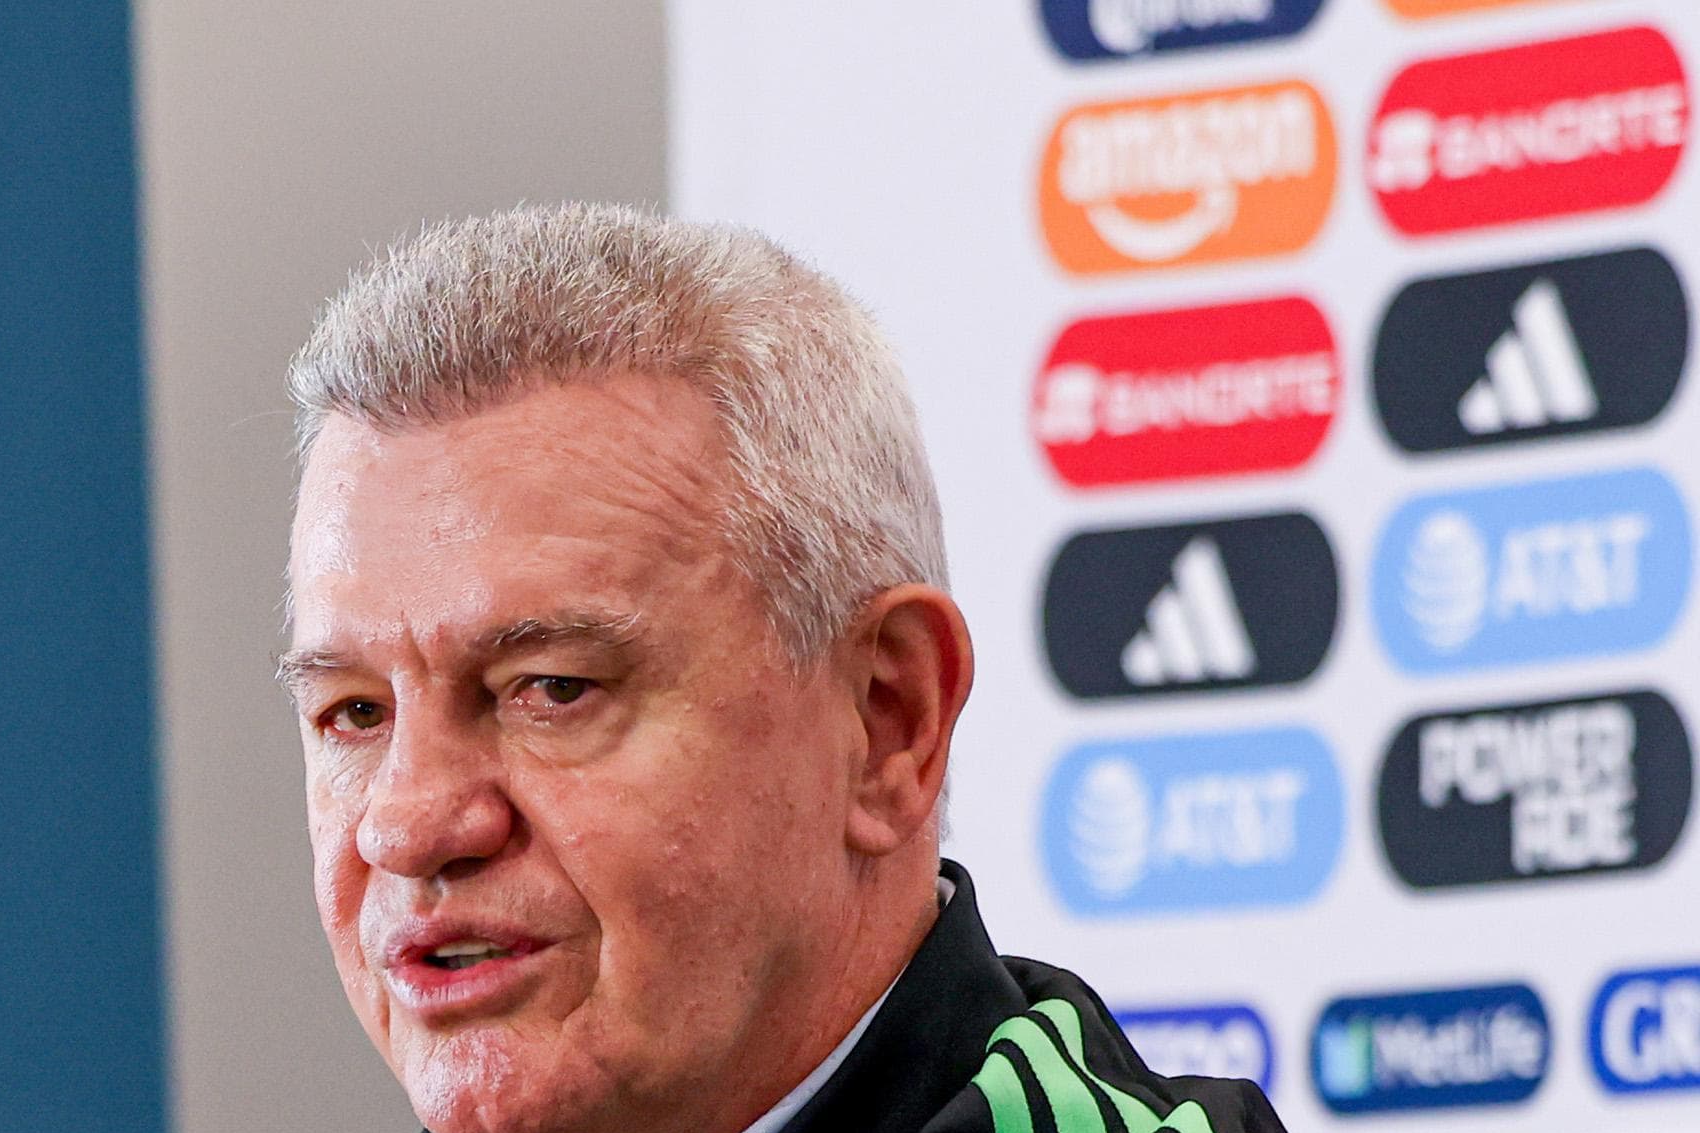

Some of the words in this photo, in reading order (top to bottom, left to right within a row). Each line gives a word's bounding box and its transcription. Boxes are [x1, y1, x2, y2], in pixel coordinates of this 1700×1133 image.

[1057, 90, 1318, 204] amazon
[1437, 83, 1684, 179] BANORTE
[1103, 351, 1336, 437] BANORTE
[1497, 514, 1651, 617] AT&T
[1417, 700, 1638, 808] POWER
[1158, 768, 1305, 868] AT&T
[1373, 1002, 1545, 1088] MetLife
